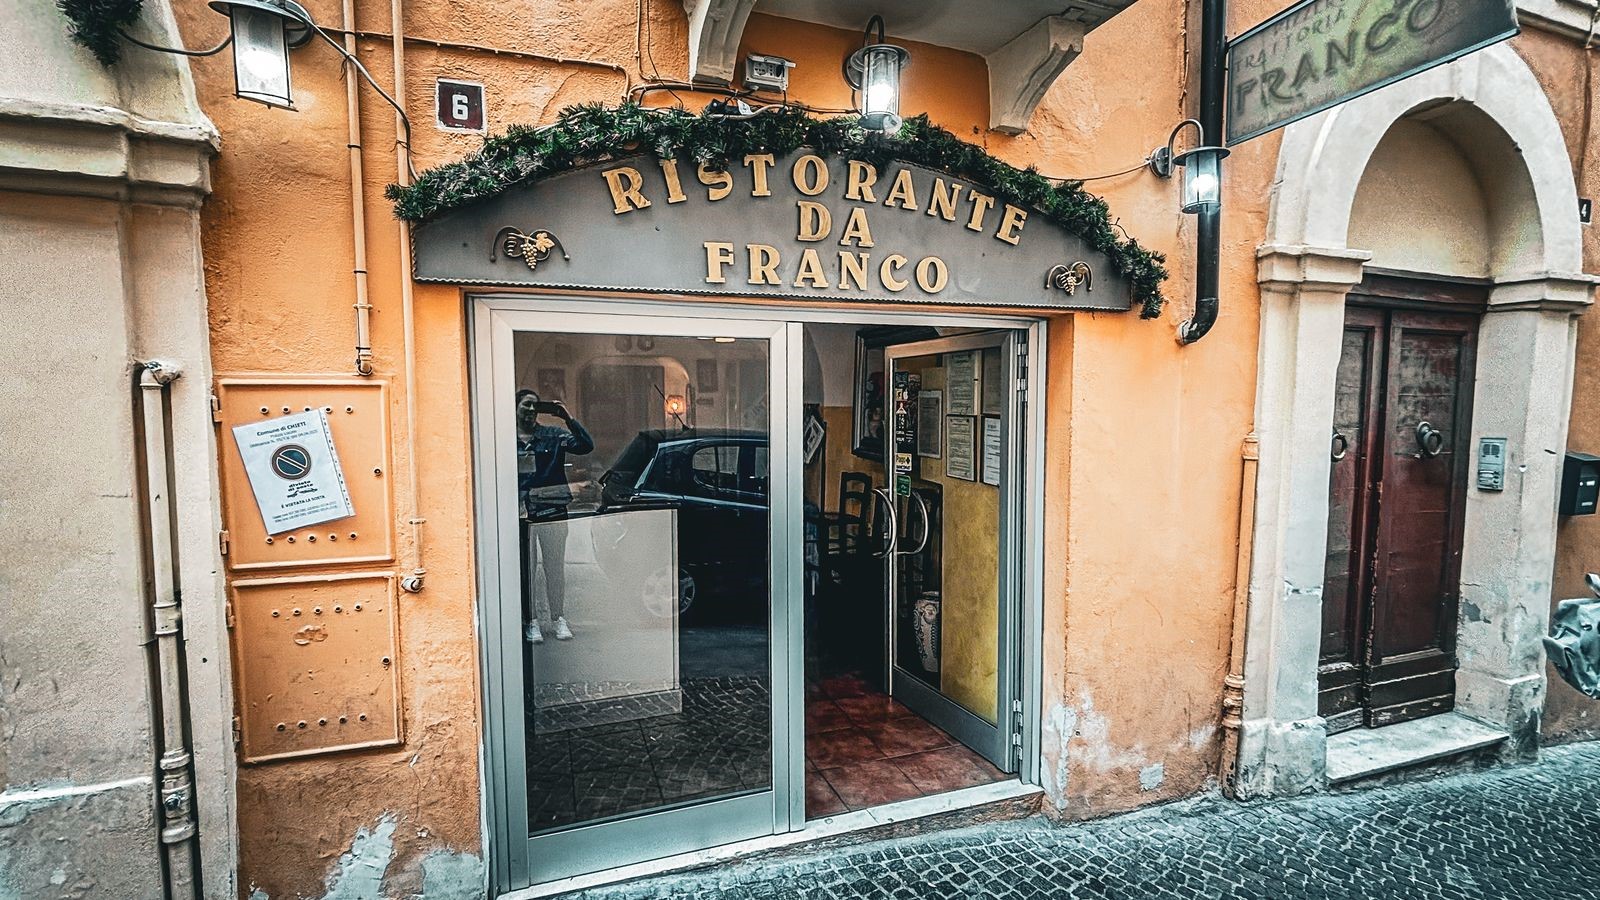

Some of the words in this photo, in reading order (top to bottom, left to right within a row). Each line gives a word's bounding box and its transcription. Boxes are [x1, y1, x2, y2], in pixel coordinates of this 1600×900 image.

[1236, 0, 1444, 117] FRANCO
[452, 94, 469, 120] 6
[602, 153, 1028, 246] RISTORANTE
[797, 200, 875, 248] DA
[703, 241, 949, 294] FRANCO
[256, 427, 280, 437] Comune
[287, 421, 307, 430] CHIETI
[285, 499, 305, 508] VIETATA
